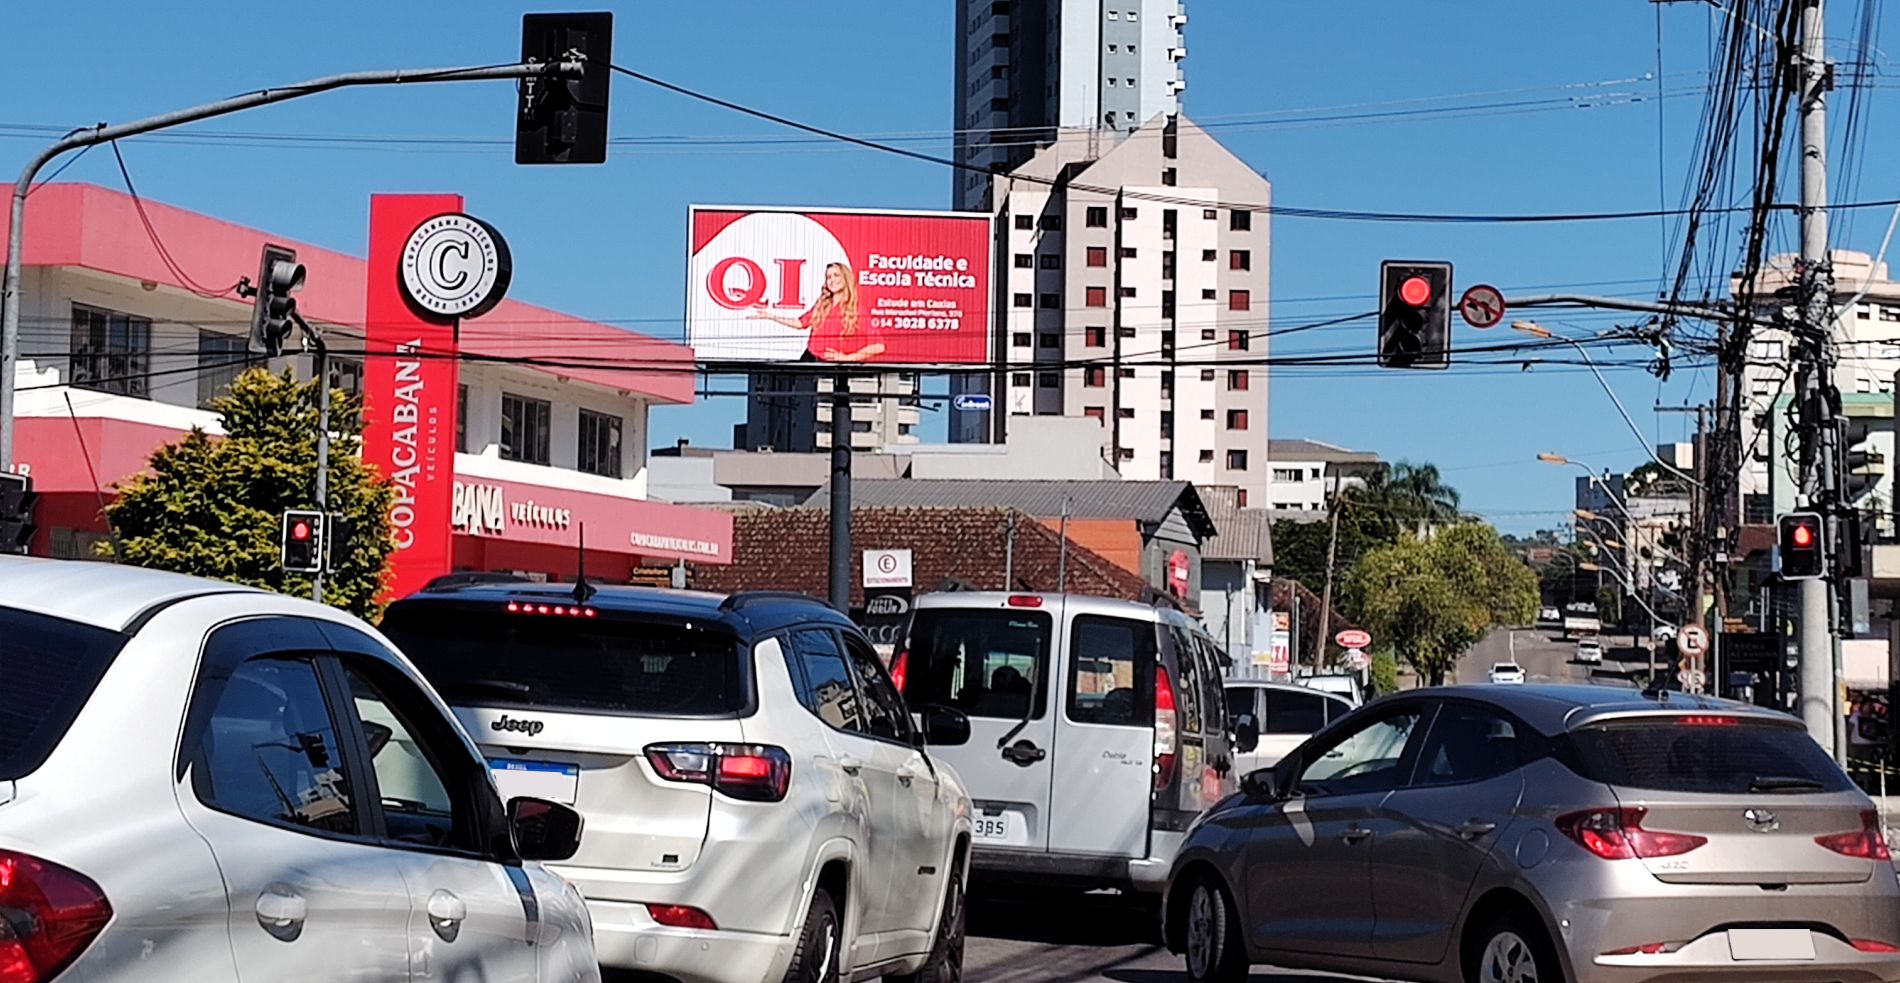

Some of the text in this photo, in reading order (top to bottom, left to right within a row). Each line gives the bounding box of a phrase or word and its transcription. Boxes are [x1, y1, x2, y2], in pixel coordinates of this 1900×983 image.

[429, 239, 470, 291] C
[868, 254, 968, 270] Faculdade e
[706, 256, 807, 311] QI
[858, 270, 976, 288] Escola Técnica
[877, 298, 957, 309] Estude em Caxias
[894, 317, 926, 330] 3028
[927, 318, 960, 331] 6378
[390, 337, 425, 550] COPACABANA
[451, 480, 571, 536] BANA VEÍCULOS
[883, 558, 892, 570] E
[491, 714, 544, 737] Jeep
